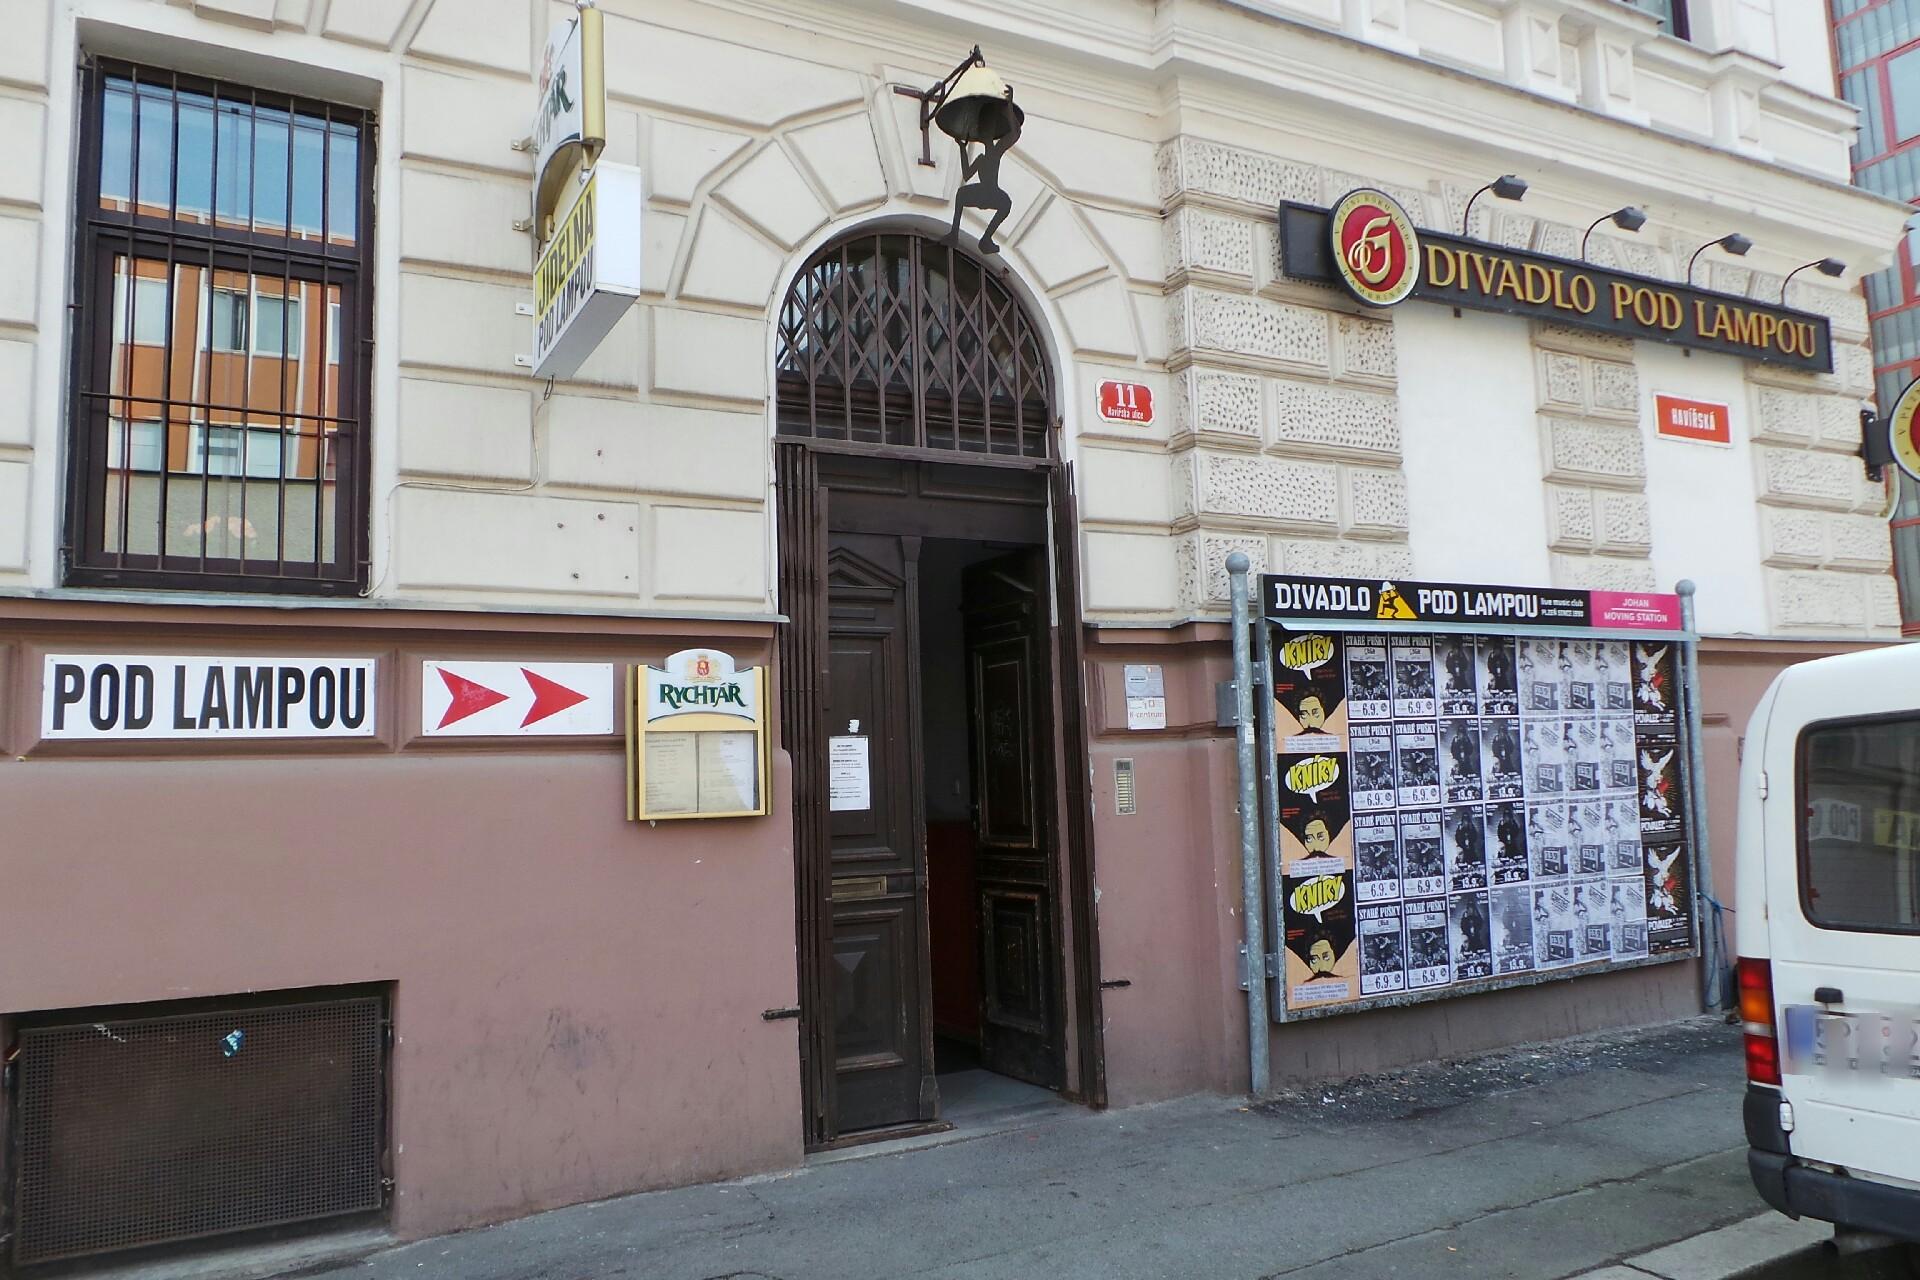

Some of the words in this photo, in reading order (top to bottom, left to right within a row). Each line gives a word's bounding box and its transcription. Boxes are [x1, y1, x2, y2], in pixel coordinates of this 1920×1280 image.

[538, 309, 555, 359] POD
[555, 245, 594, 334] LAMPOU
[1424, 243, 1598, 315] DIVADLO
[1610, 281, 1684, 332] POD
[1694, 300, 1819, 359] LAMPOU
[1116, 384, 1137, 408] 11
[1671, 407, 1717, 431] HAVÍŘSKÁ
[1274, 582, 1370, 612] DIVADLO
[1418, 589, 1457, 615] POD
[1463, 591, 1539, 618] LAMPOU
[1553, 598, 1570, 606] music
[1570, 598, 1584, 607] club
[1622, 598, 1649, 608] JOHAN
[1604, 612, 1635, 621] MOVING
[1636, 613, 1668, 623] STATION
[1284, 632, 1332, 668] KNÍRY
[53, 663, 154, 731] POD
[173, 664, 366, 731] LAMPOU
[659, 682, 749, 709] RYCHTÁŘ
[1362, 703, 1379, 716] 6.9.
[1408, 701, 1424, 714] 6.9.
[1290, 755, 1337, 792] KNÍRY
[1367, 793, 1384, 806] 6.9.
[1412, 789, 1429, 802] 6.9.
[1294, 874, 1342, 913] KNÍRY
[1371, 883, 1388, 897] 6.9.
[1417, 880, 1434, 893] 6.9.
[1375, 976, 1392, 989] 6.9.
[1422, 969, 1439, 983] 6.9.
